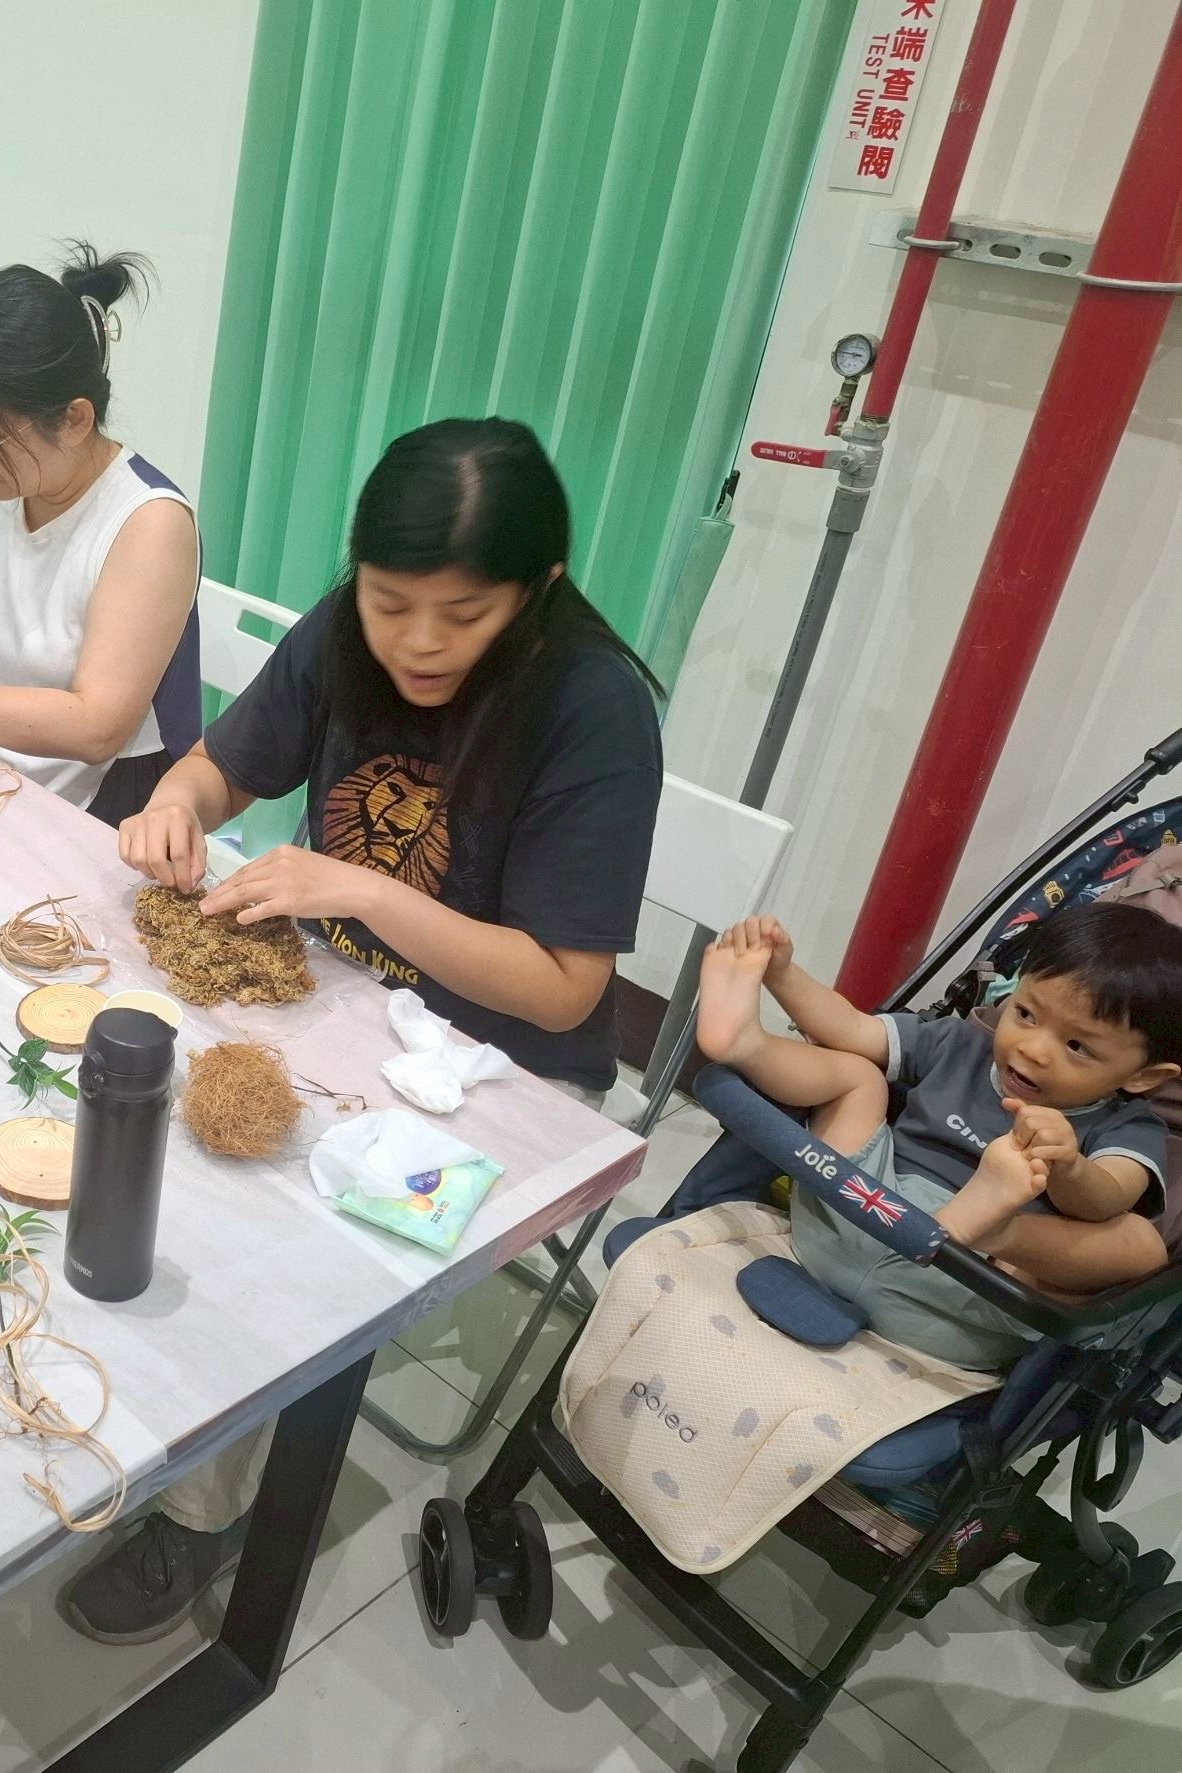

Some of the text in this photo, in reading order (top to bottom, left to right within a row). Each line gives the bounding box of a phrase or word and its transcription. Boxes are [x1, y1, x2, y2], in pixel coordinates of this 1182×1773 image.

[863, 33, 890, 79] TEST
[849, 88, 875, 128] UNIT
[629, 1382, 698, 1443] poled
